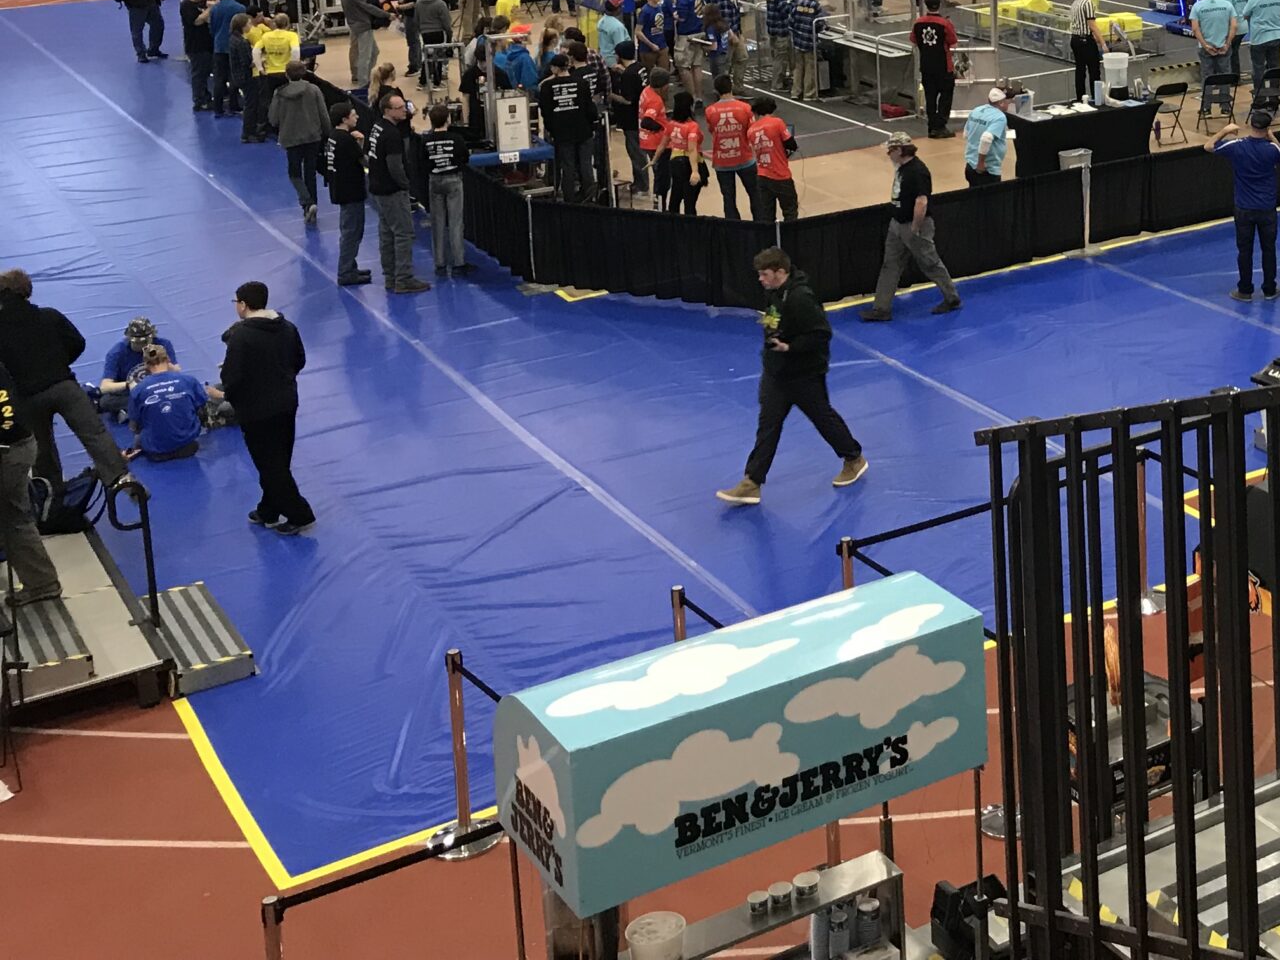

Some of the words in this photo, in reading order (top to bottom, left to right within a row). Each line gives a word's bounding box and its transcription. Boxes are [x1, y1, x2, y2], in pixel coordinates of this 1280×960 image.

[716, 149, 742, 159] FedEx
[719, 137, 741, 150] 3M
[676, 829, 734, 860] VERMONT'S
[735, 819, 767, 840] FINEST
[774, 809, 790, 823] ICE
[789, 797, 825, 819] CREAM
[834, 780, 872, 802] FROZEN
[872, 766, 910, 788] YOGURT
[510, 799, 564, 888] JERRY'S
